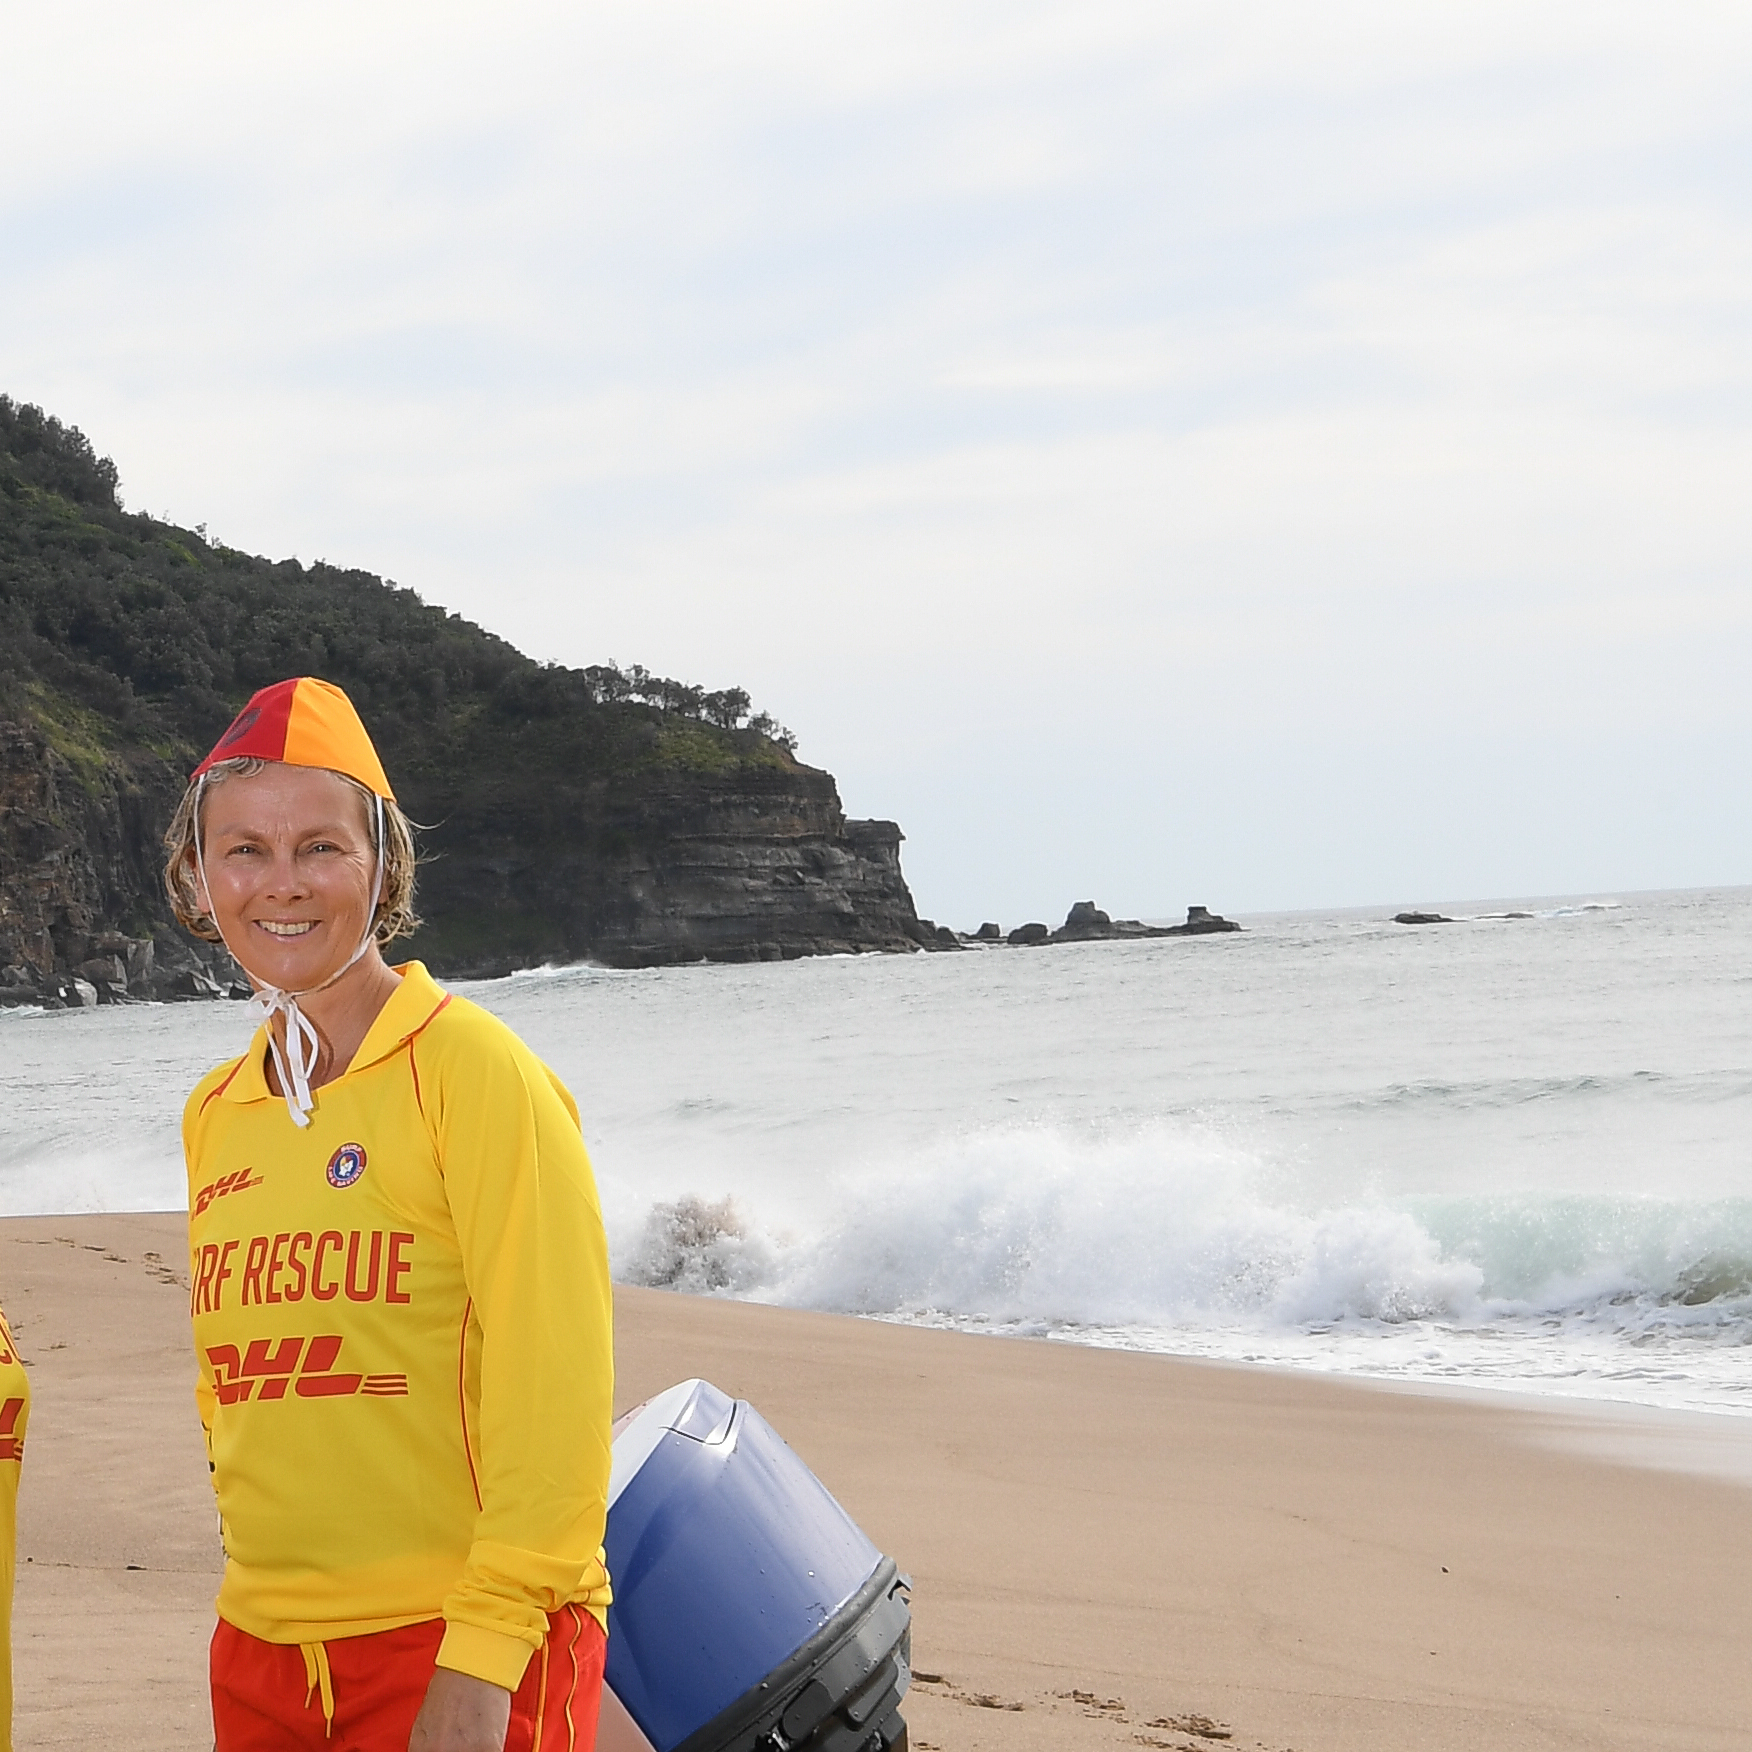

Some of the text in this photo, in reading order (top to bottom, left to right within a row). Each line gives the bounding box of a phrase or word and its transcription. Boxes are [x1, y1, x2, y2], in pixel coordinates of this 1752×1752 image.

[194, 1166, 252, 1216] DHL
[241, 1230, 415, 1306] RESCUE
[205, 1334, 363, 1406] DHL
